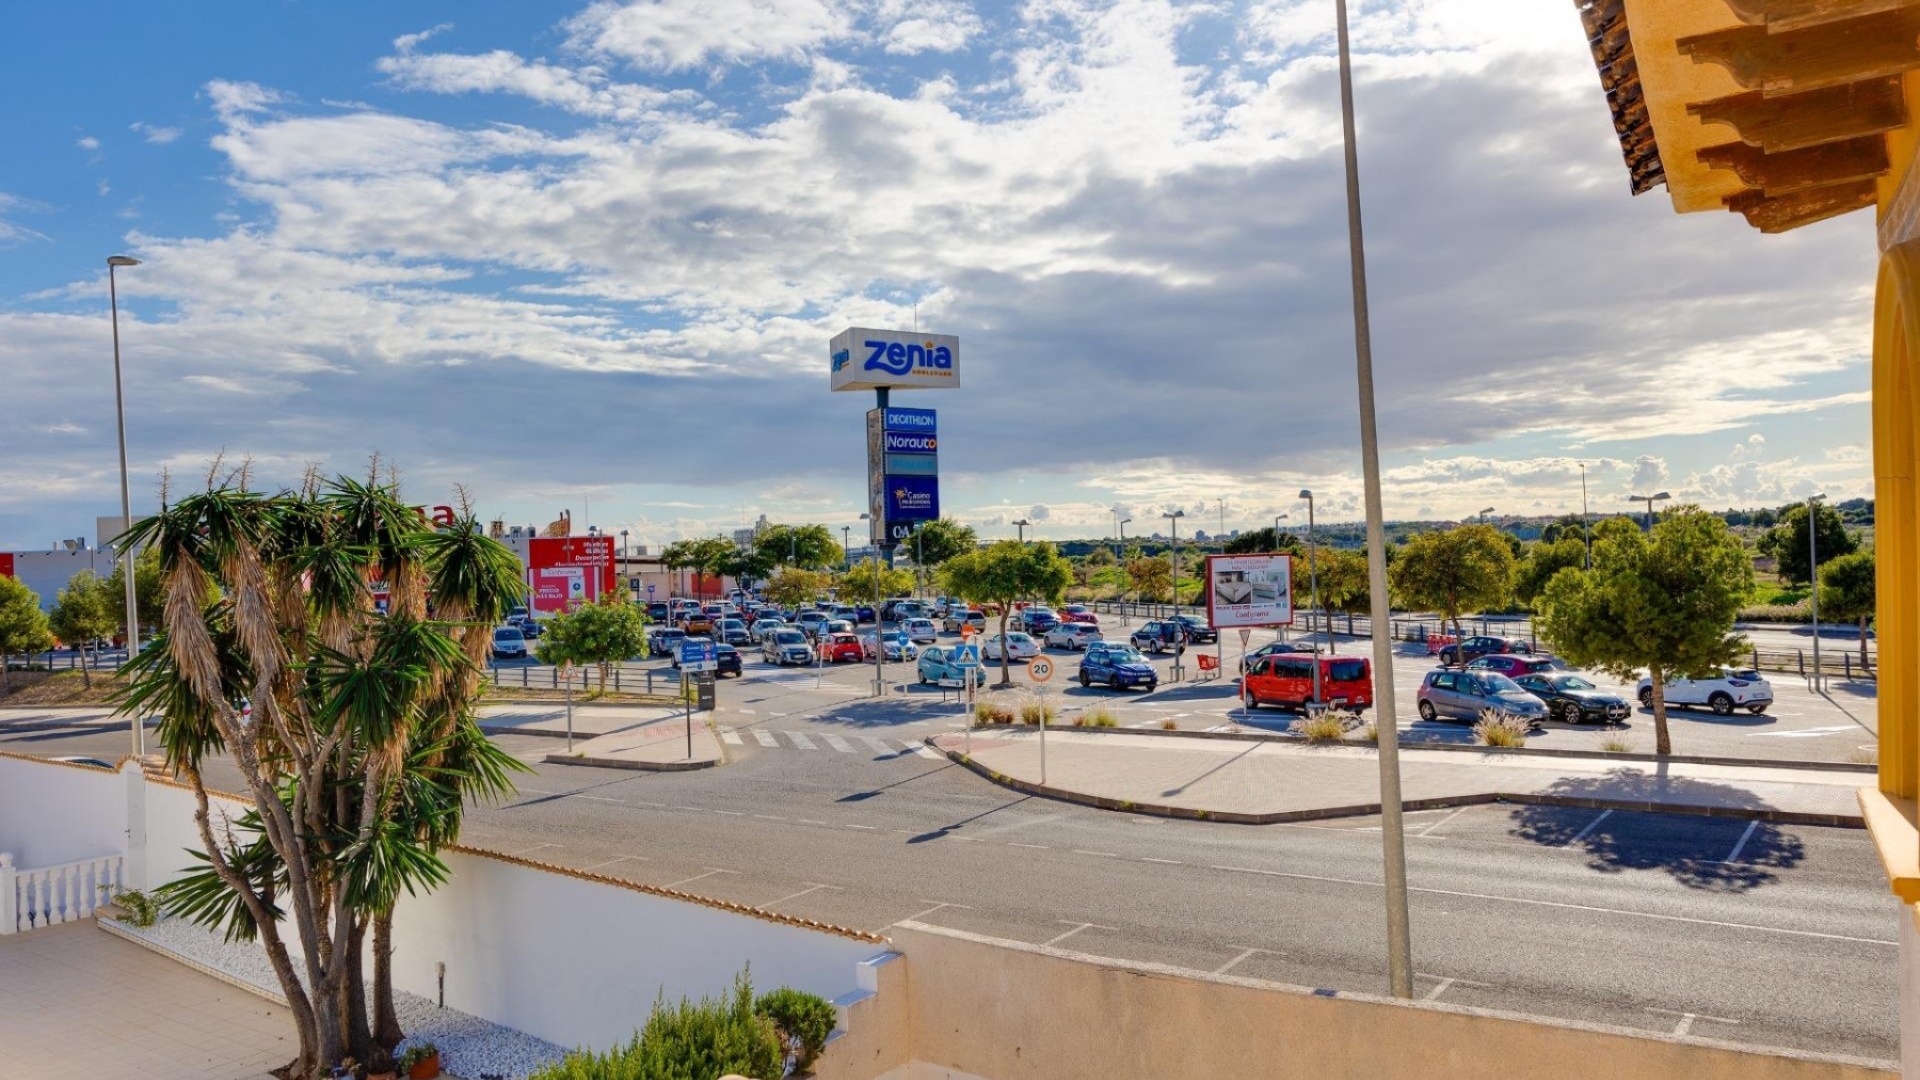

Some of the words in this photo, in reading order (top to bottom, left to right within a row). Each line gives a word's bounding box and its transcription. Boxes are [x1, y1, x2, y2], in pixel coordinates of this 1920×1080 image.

[888, 414, 934, 426] DECATHLON
[887, 435, 937, 449] Norauto
[907, 491, 931, 499] Casino
[1034, 664, 1048, 673] 20
